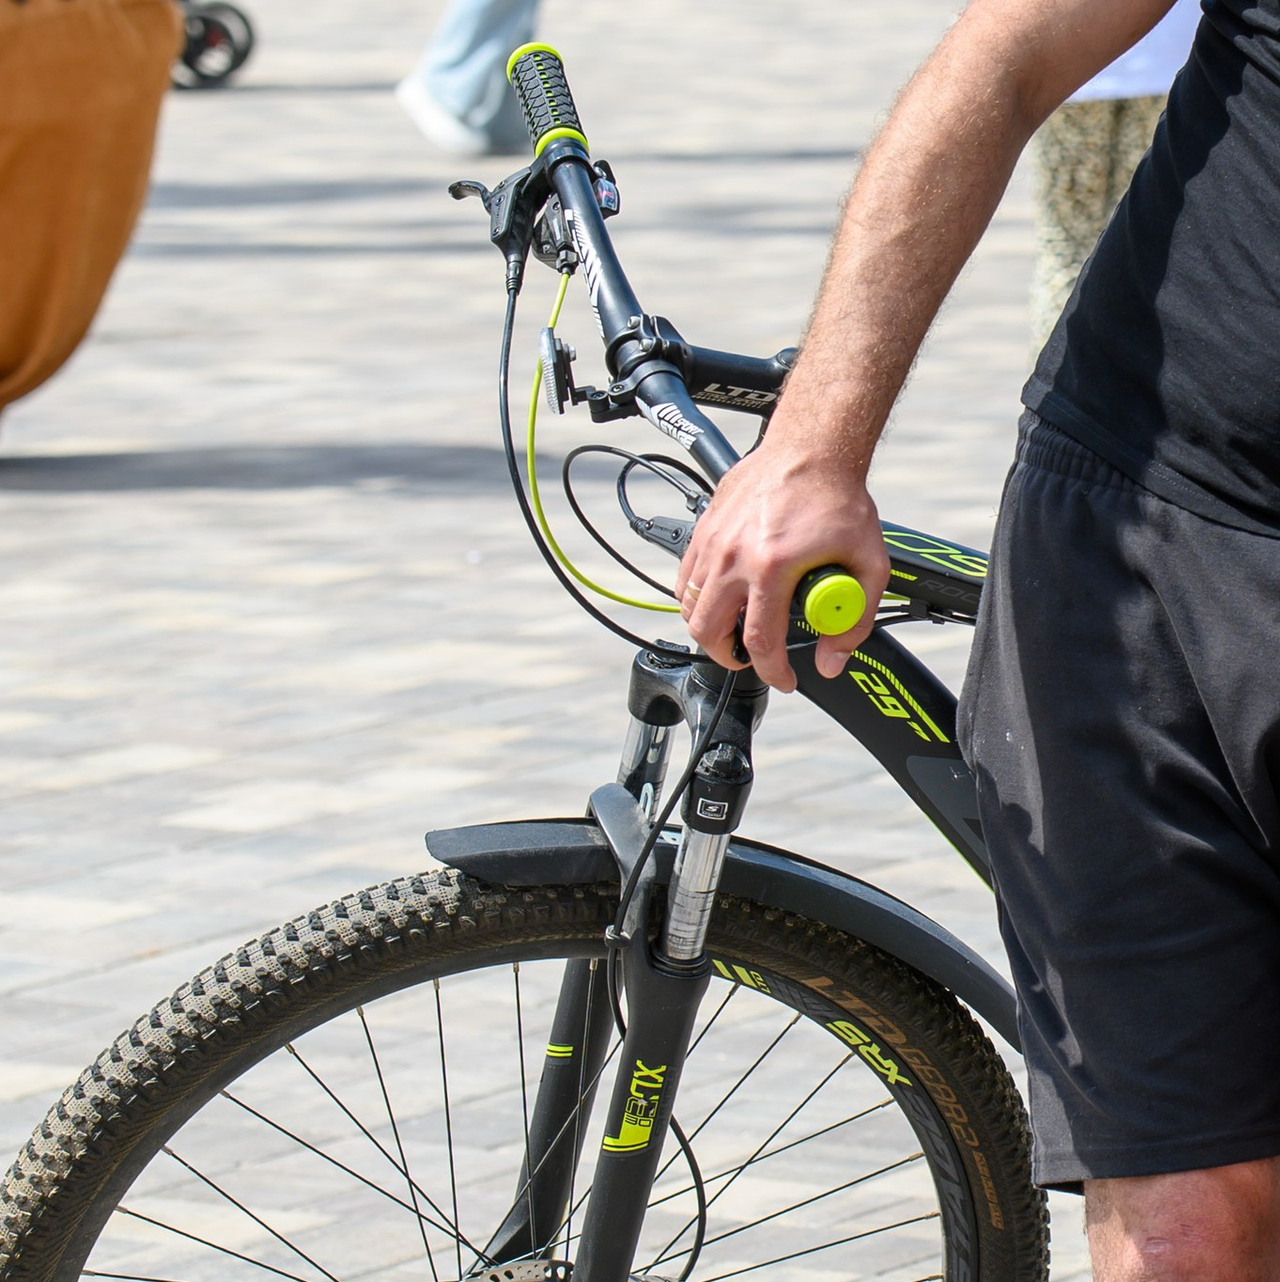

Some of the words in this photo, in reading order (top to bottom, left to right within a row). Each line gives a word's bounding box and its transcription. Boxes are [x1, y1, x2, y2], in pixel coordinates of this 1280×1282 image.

[703, 383, 777, 402] LTD
[674, 418, 705, 434] SPORT
[801, 976, 907, 1044] LTD
